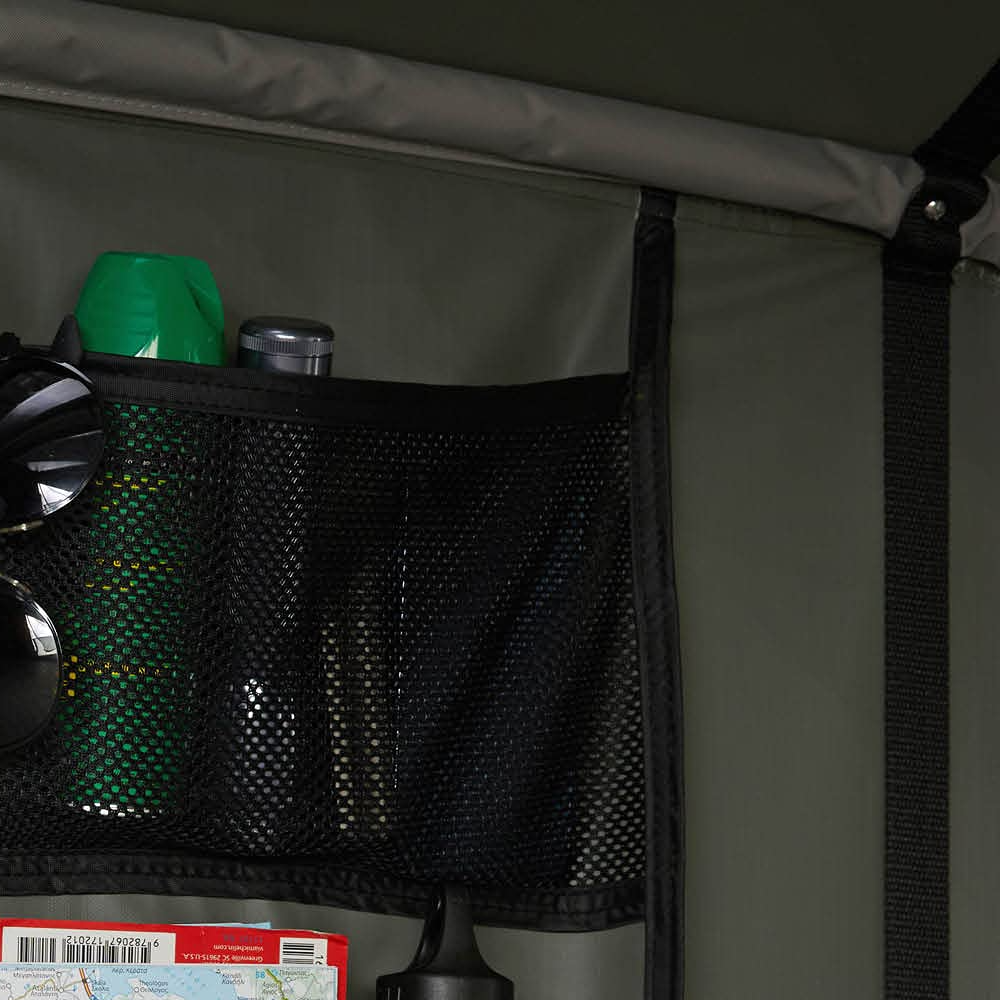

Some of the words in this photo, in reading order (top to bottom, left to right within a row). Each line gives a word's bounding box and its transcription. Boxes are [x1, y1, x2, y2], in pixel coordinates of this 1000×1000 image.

[66, 935, 103, 945] 172012
[110, 937, 147, 947] 782067
[153, 938, 160, 947] 9
[213, 944, 264, 952] viamichelin.com
[233, 954, 264, 962] Greenville
